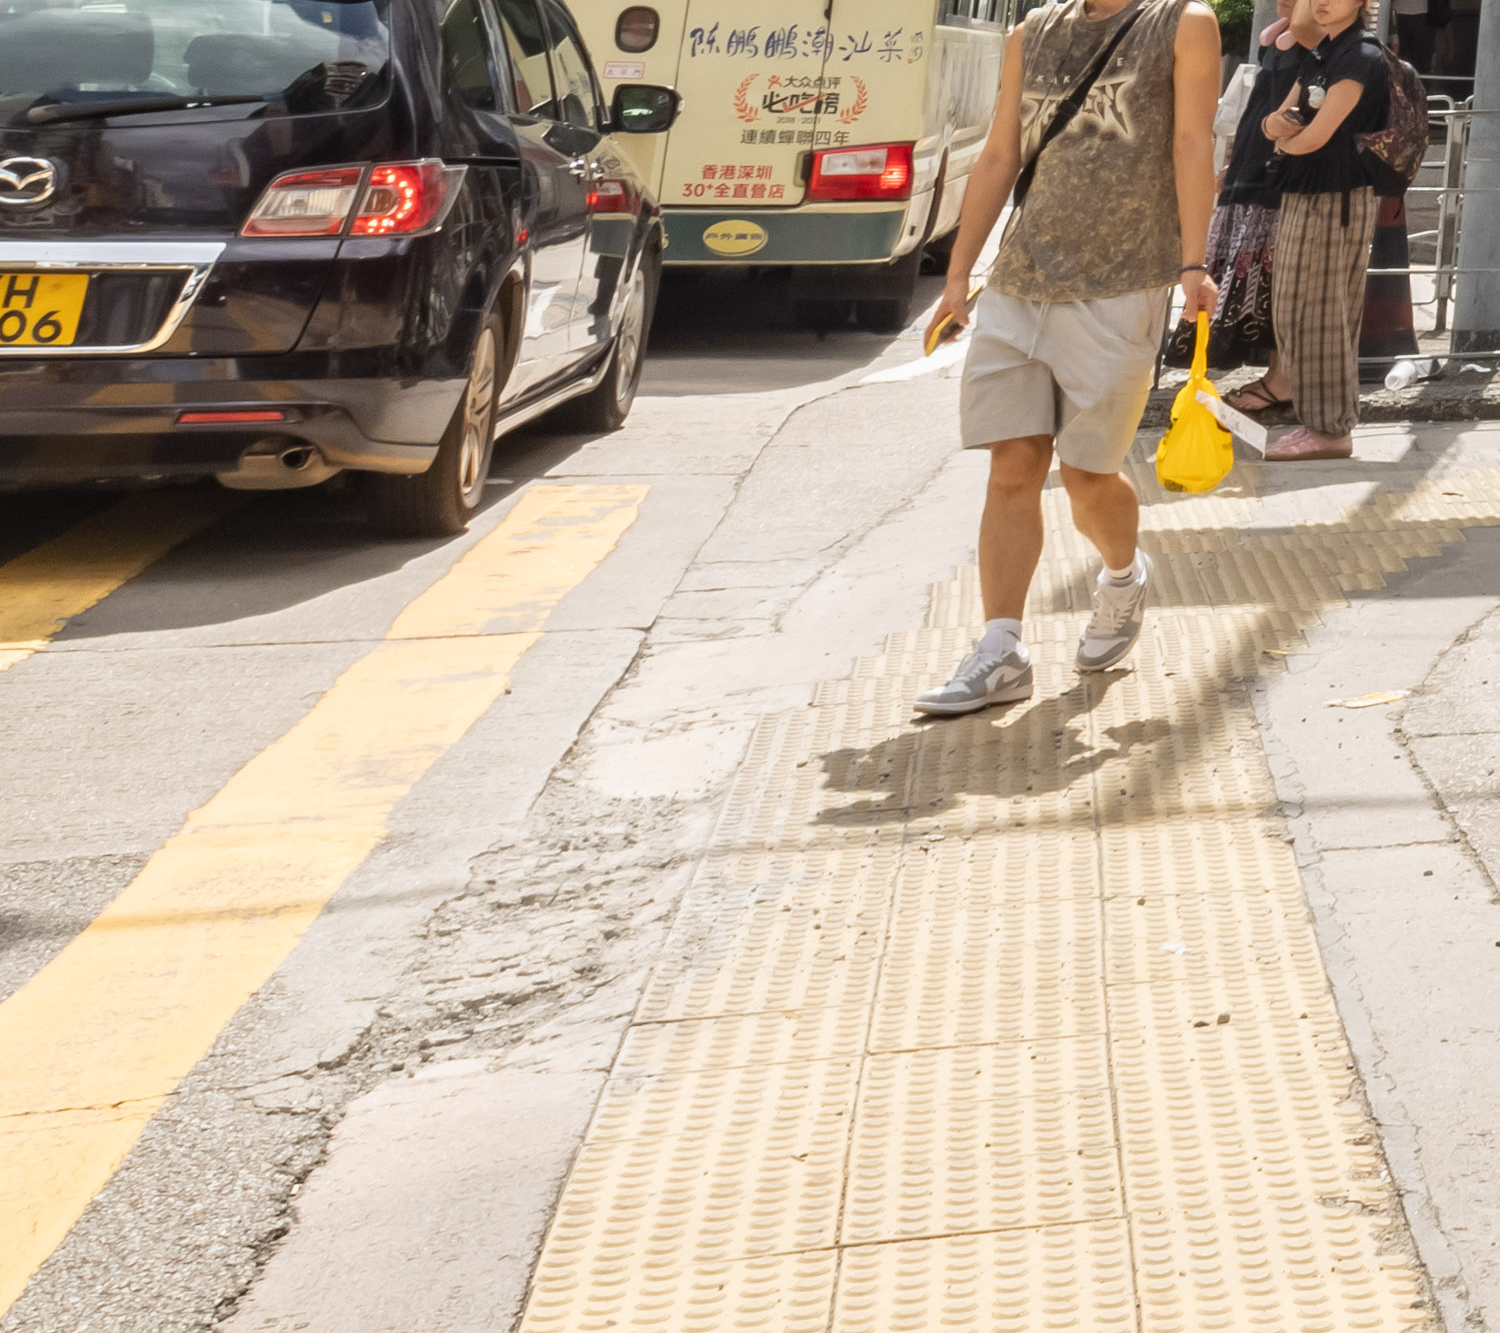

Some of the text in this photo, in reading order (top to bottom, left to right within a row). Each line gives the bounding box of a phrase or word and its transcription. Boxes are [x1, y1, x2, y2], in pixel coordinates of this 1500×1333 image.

[784, 76, 842, 89] 大众点评
[761, 90, 840, 116] 必吃榜
[701, 164, 773, 181] 香港深圳
[0, 275, 40, 309] H
[0, 309, 63, 344] 06
